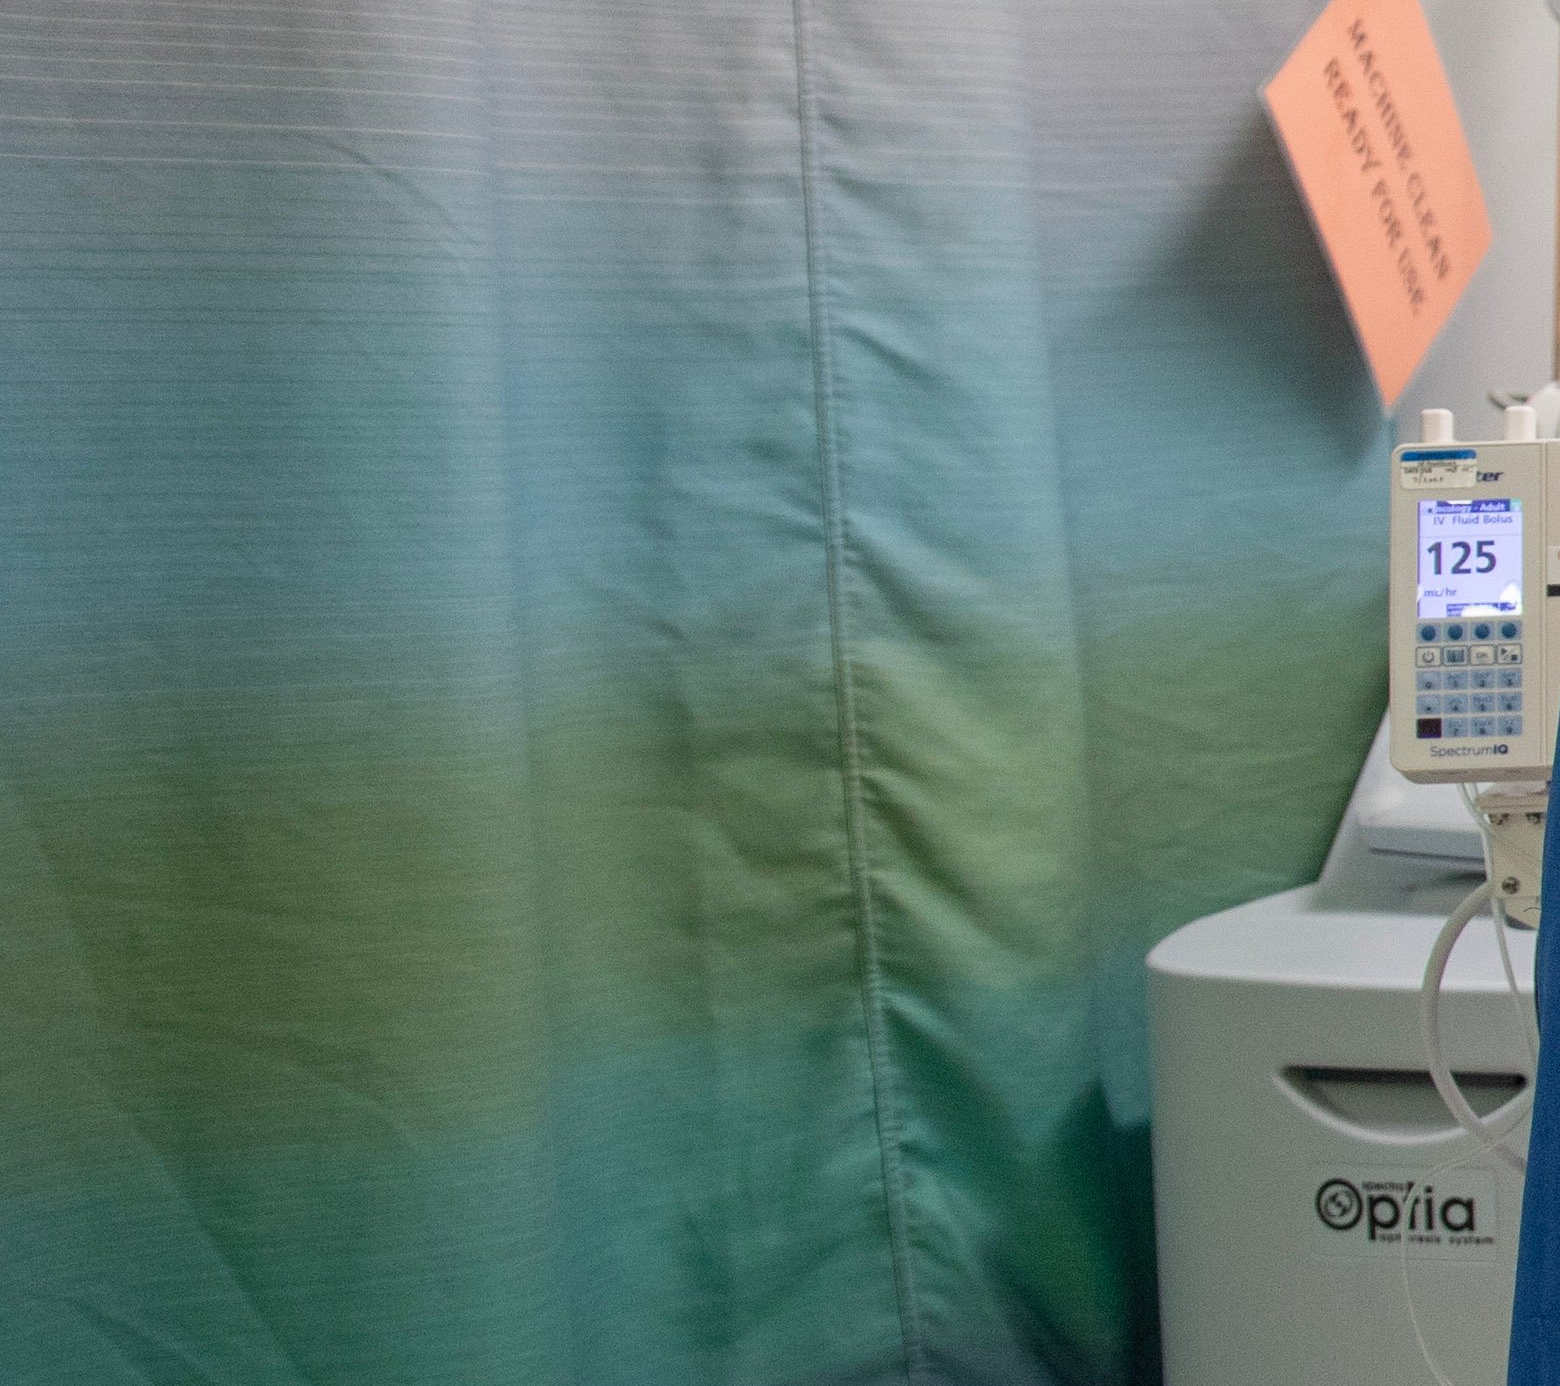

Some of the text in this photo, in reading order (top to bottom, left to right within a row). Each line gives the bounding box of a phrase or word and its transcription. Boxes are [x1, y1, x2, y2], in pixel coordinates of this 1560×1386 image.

[1323, 57, 1381, 173] READY
[1371, 176, 1402, 250] FOR
[1346, 18, 1449, 281] MACHINE CLEAN
[1433, 513, 1513, 526] IV Fluid Bolus
[1426, 539, 1497, 575] 125
[1429, 744, 1509, 757] SpectrumIQ
